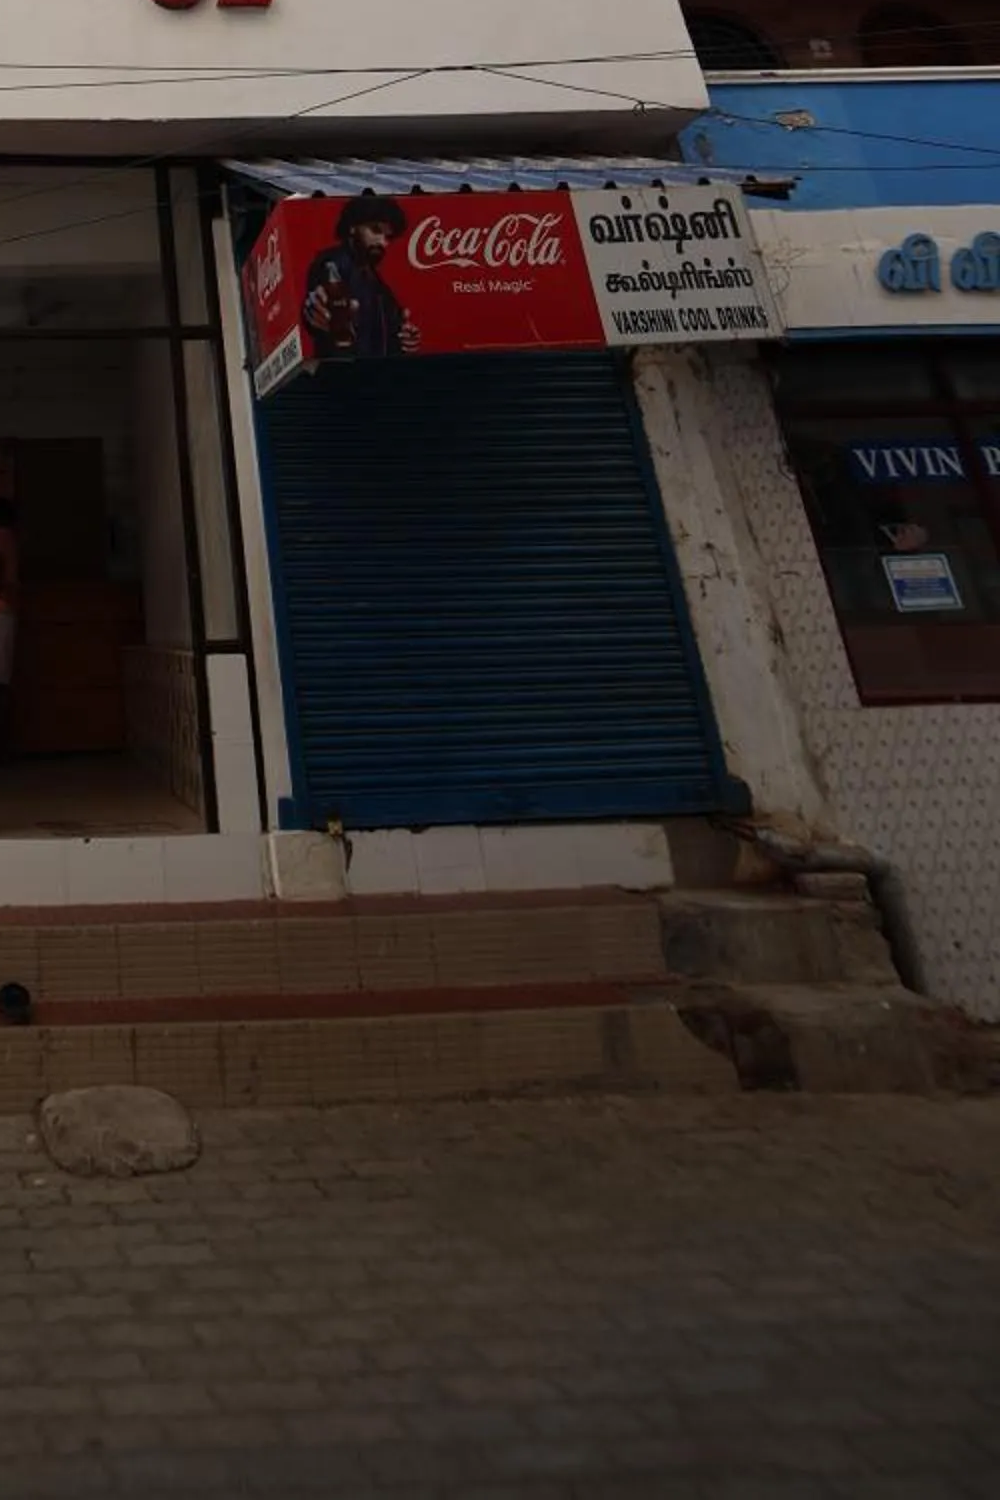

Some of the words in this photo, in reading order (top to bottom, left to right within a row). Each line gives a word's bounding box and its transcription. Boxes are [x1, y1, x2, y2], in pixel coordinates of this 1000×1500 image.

[407, 212, 563, 271] Coca-Cola
[453, 281, 486, 294] Real
[488, 279, 533, 295] Magic
[611, 309, 679, 335] VARSHINI
[679, 307, 717, 332] COOL
[716, 304, 769, 331] DRINKS
[852, 446, 966, 478] VIVIN
